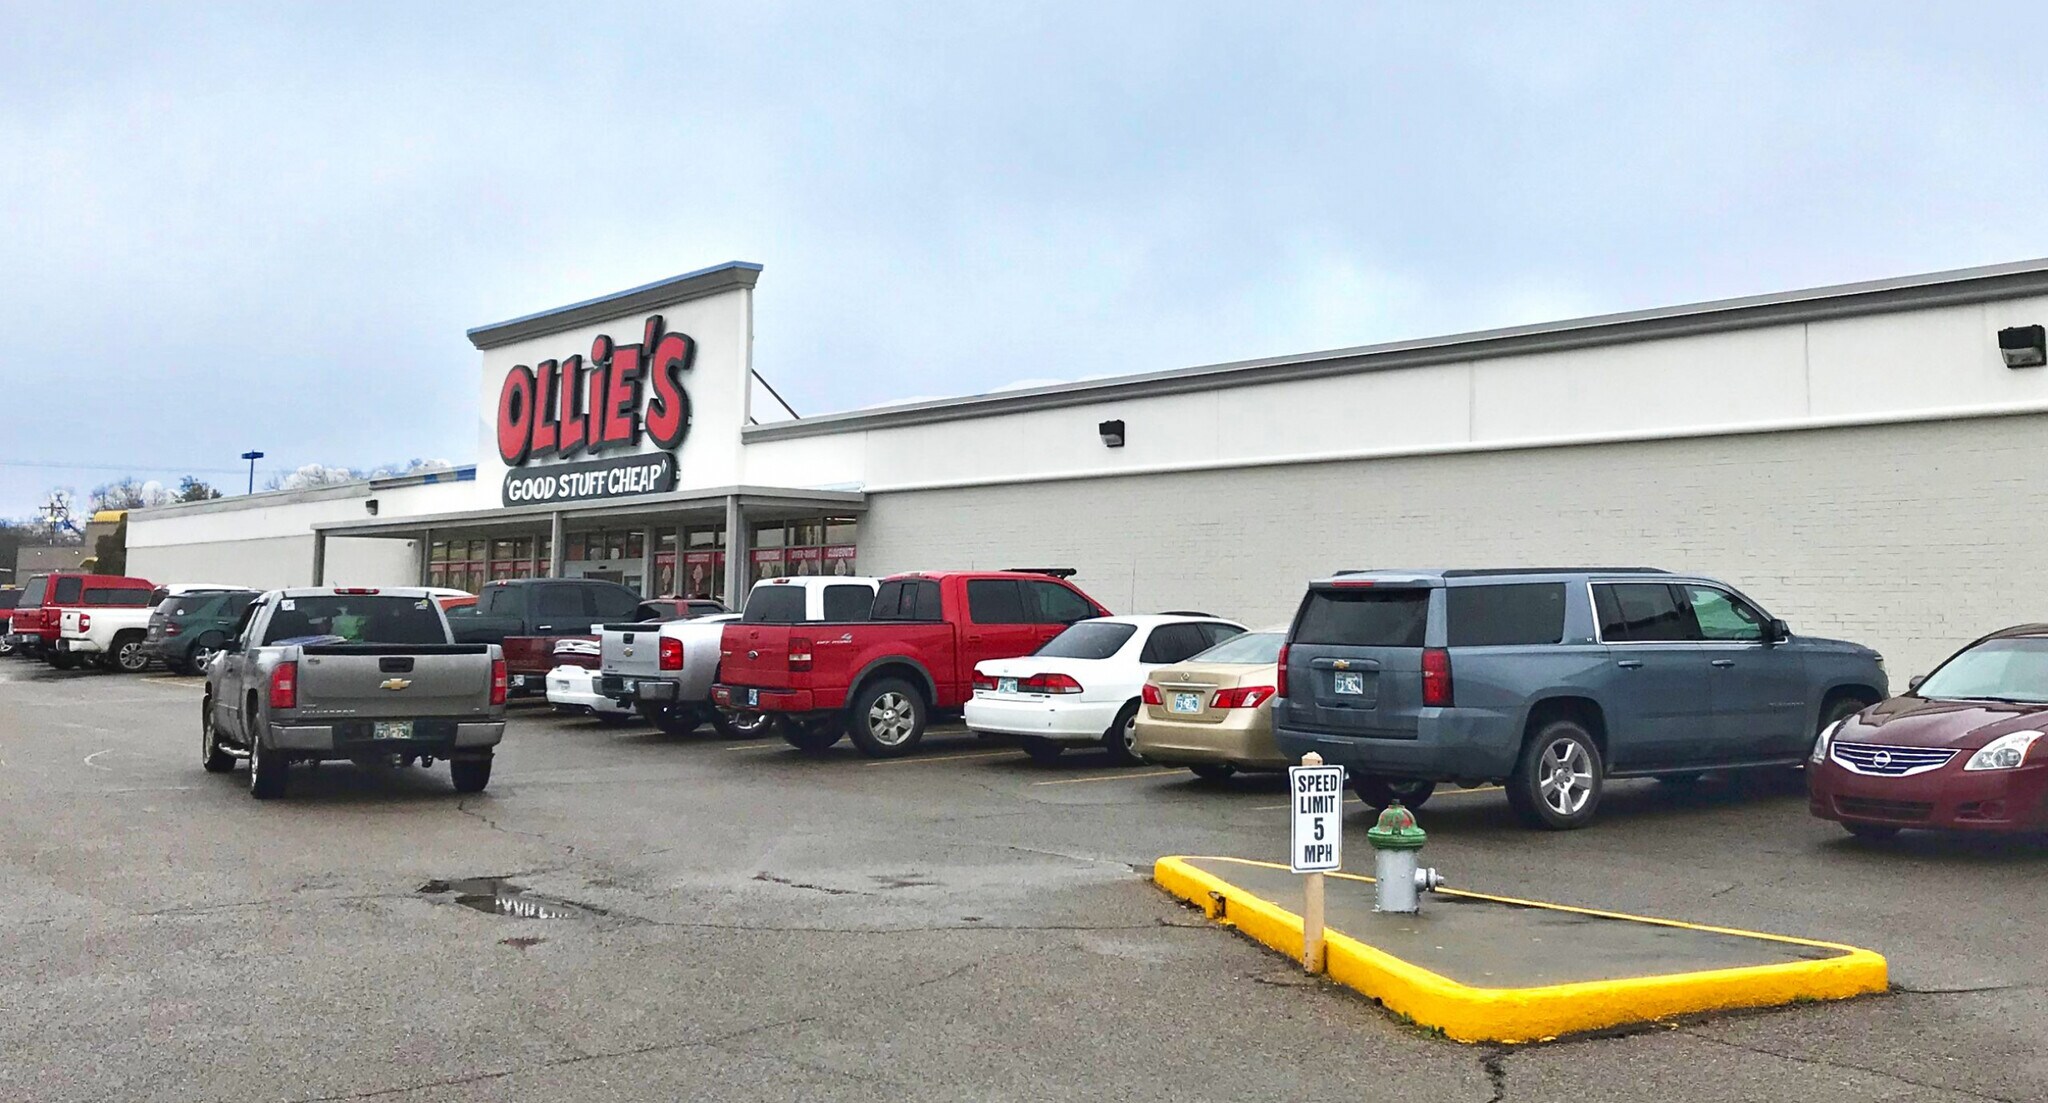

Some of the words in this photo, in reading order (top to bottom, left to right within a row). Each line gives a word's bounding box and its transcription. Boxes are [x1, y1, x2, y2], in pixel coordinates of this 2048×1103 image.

[558, 469, 608, 498] STUFF
[1298, 774, 1337, 793] SPEED
[1300, 795, 1335, 814] LIMIT
[1314, 817, 1325, 841] 5
[1304, 844, 1332, 863] MPH
